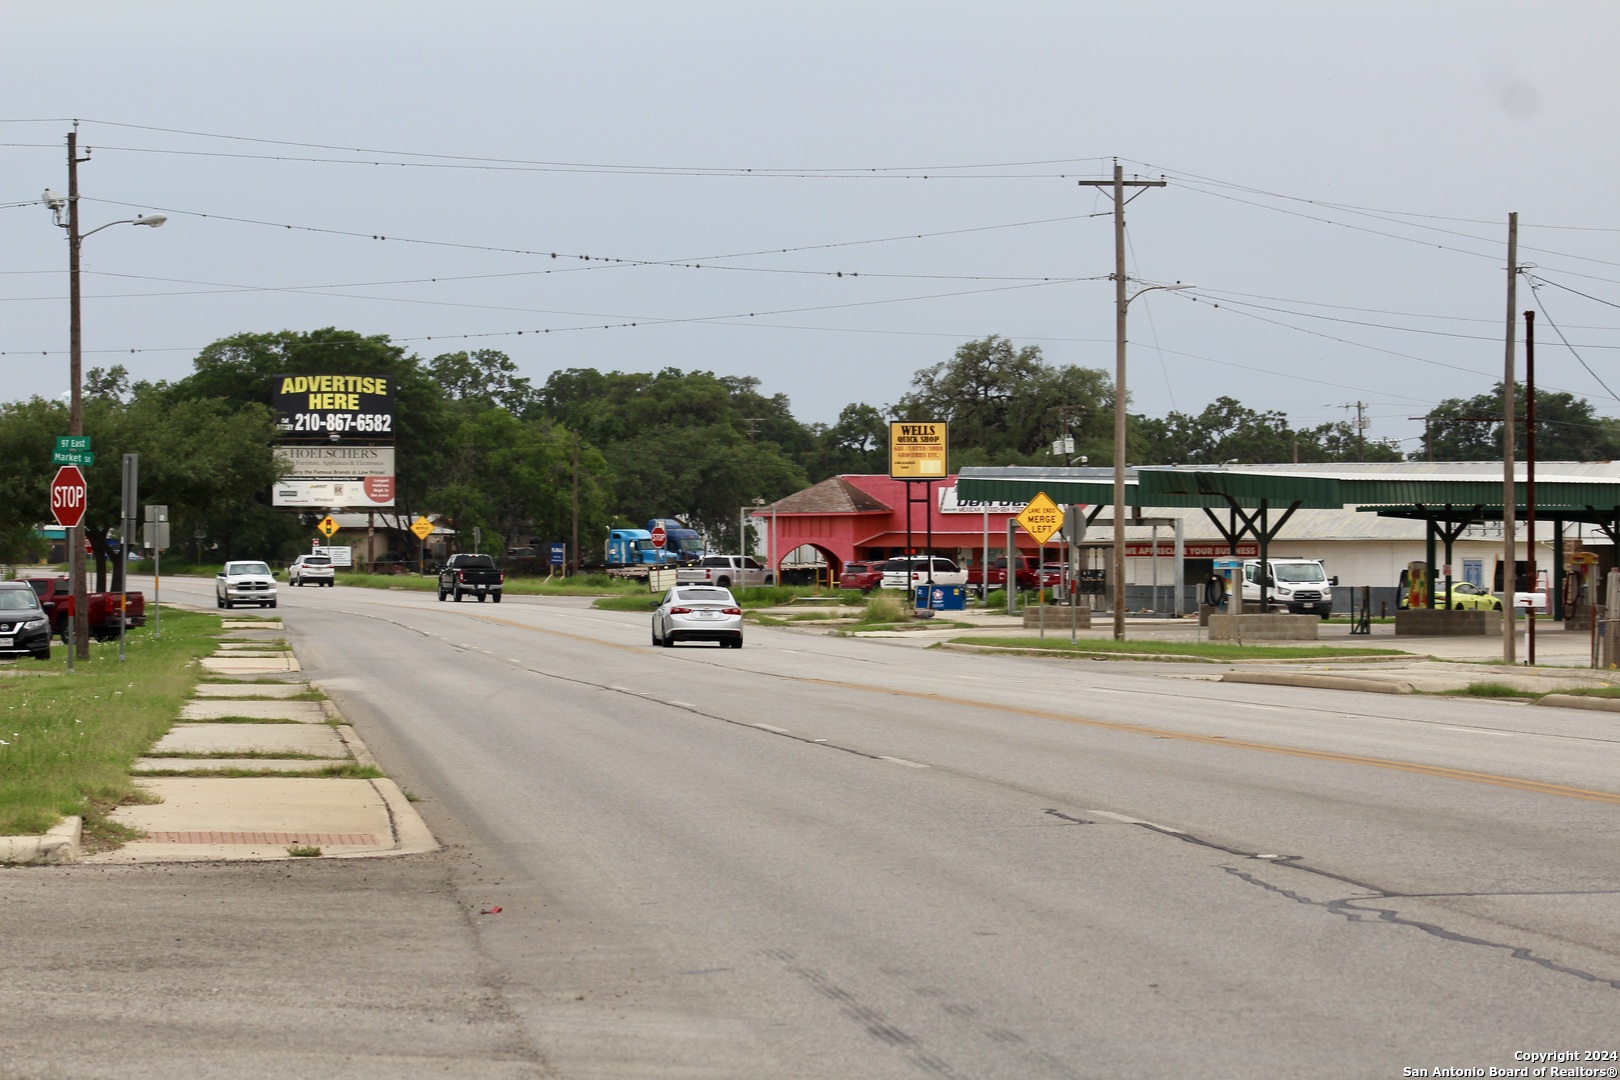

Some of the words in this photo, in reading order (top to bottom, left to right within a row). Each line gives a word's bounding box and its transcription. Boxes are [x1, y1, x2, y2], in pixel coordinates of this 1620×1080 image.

[281, 376, 387, 395] ADVERTISE
[309, 394, 359, 410] HERE
[295, 414, 391, 432] 210-867-6582
[901, 426, 935, 435] WELLS
[55, 453, 81, 462] Market
[54, 486, 83, 508] STOP
